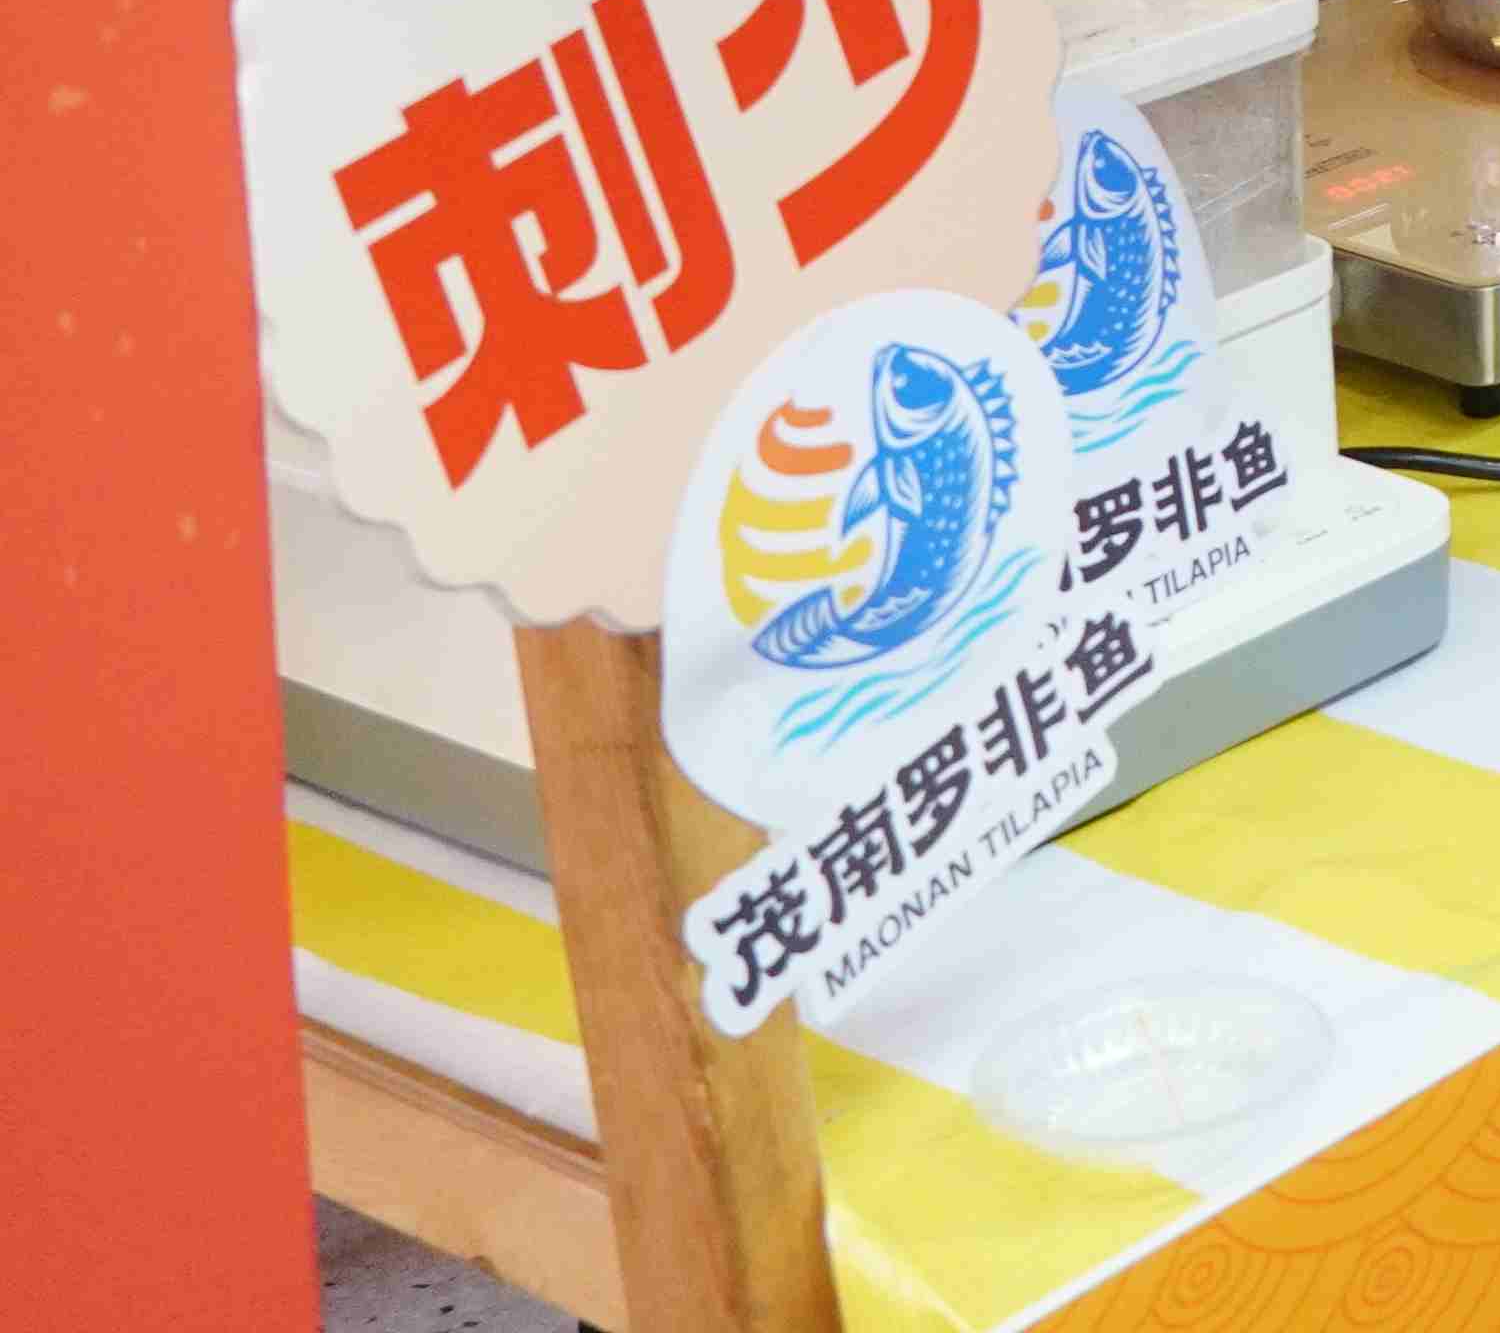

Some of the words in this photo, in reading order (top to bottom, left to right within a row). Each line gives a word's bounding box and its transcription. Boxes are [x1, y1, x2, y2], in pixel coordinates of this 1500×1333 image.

[1058, 420, 1288, 592] 罗非鱼
[1143, 535, 1251, 605] TILAPIA
[712, 610, 1155, 1008] 茂南罗非鱼
[822, 853, 975, 998] MAONAN
[977, 746, 1104, 860] TILAPIA
